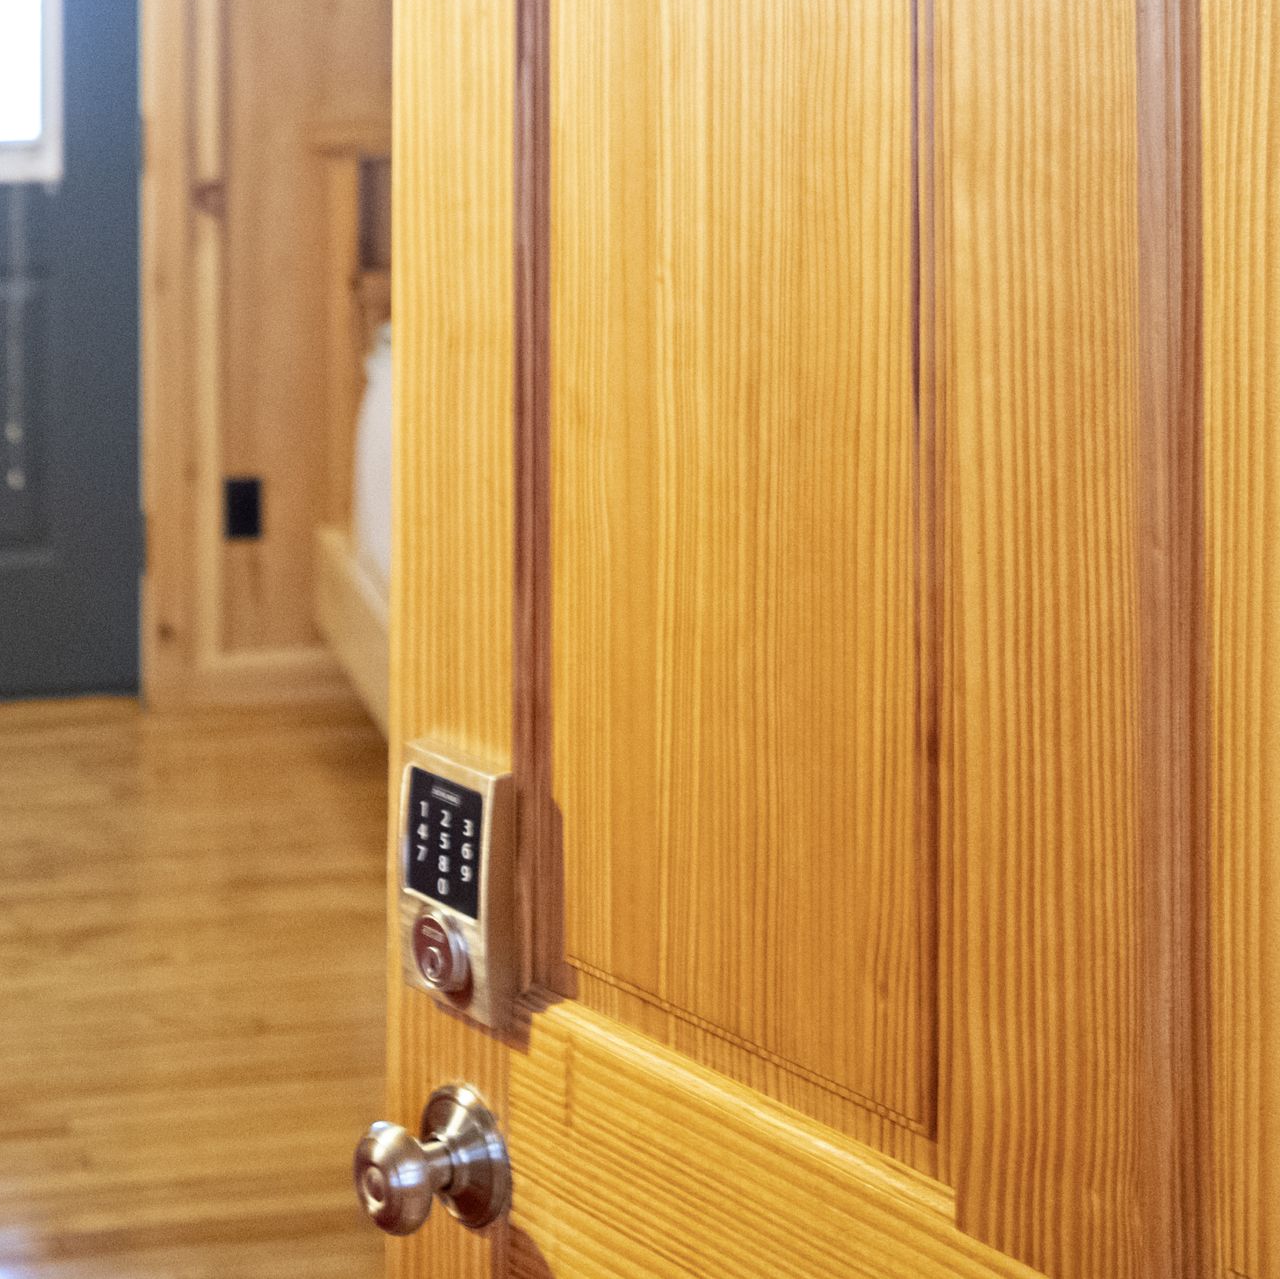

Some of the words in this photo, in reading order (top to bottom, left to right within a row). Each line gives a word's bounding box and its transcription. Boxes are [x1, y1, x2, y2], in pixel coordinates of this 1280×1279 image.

[418, 800, 428, 817] 1
[440, 809, 451, 828] 2
[463, 818, 474, 837] 3
[416, 823, 428, 840] 4
[439, 831, 450, 850] 5
[460, 842, 472, 860] 6
[415, 844, 427, 862] 7
[437, 854, 449, 873] 8
[459, 864, 472, 882] 9
